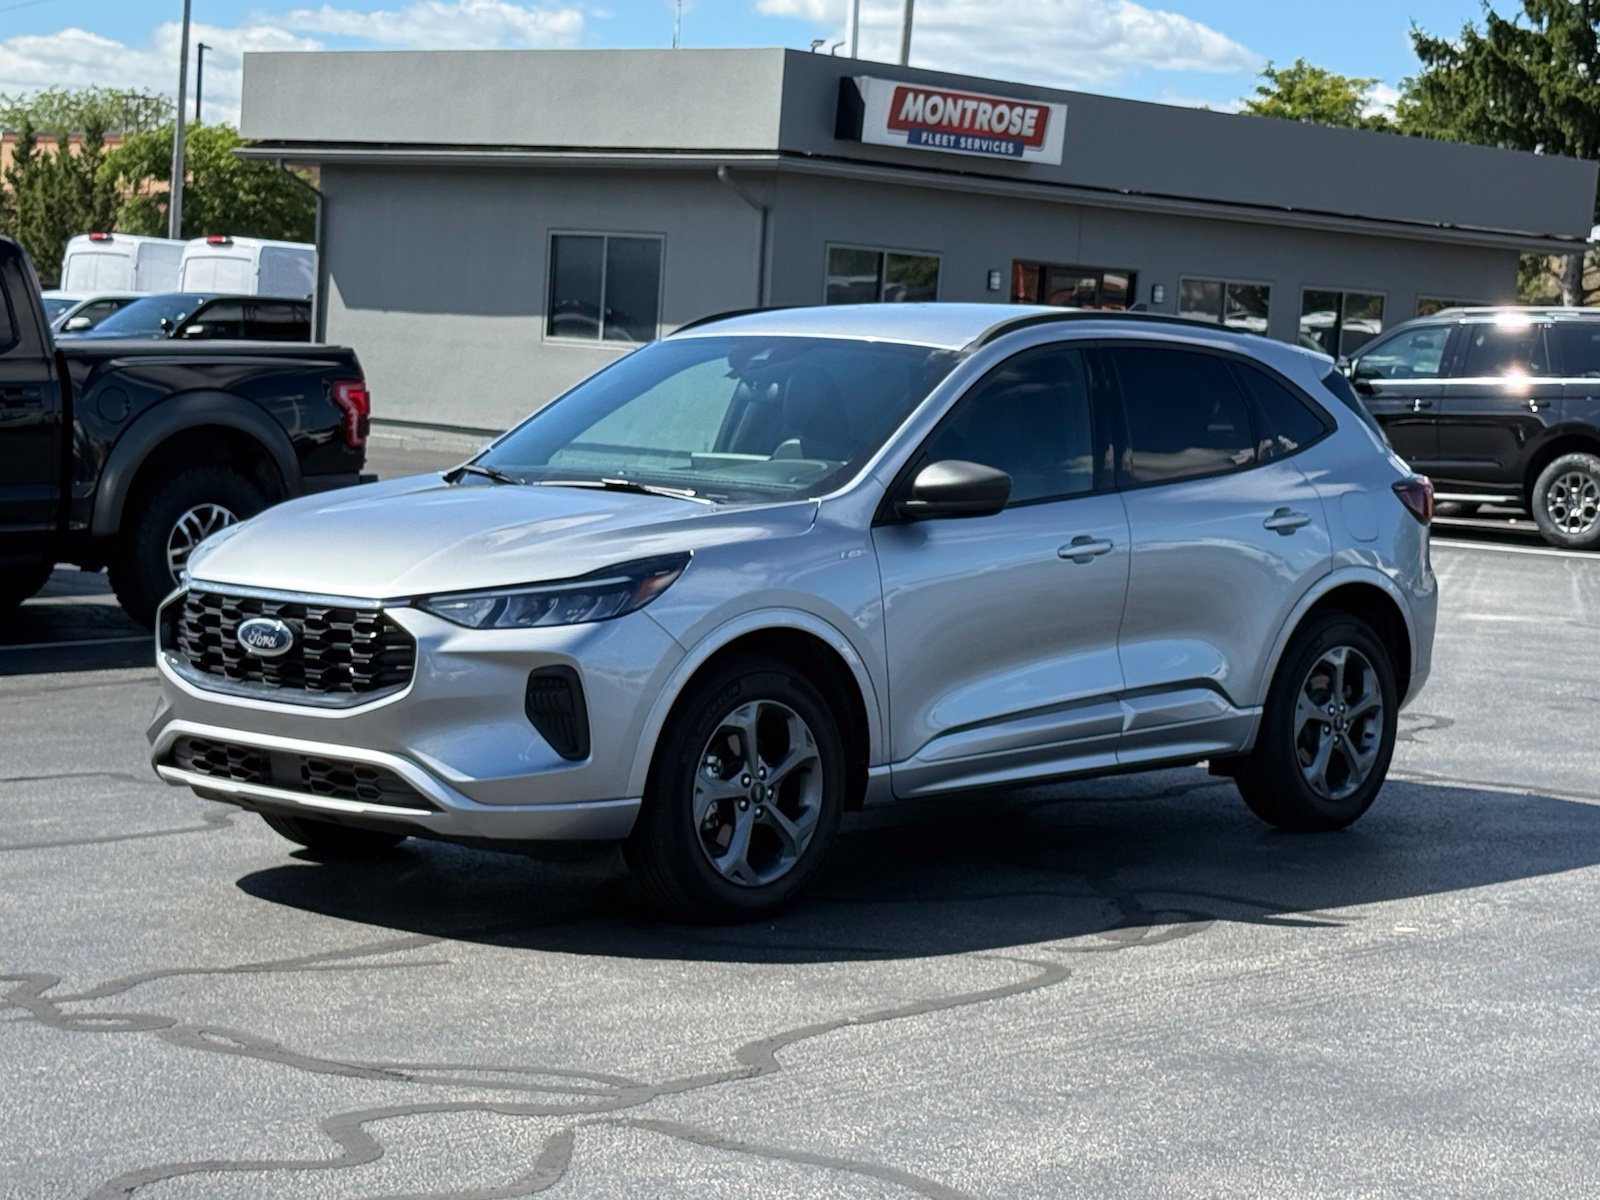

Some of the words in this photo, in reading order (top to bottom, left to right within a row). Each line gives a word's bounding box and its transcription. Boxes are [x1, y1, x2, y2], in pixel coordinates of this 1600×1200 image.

[899, 91, 1039, 137] MONTROSE
[921, 132, 956, 147] FLEET
[959, 135, 1015, 154] SERVICES
[247, 627, 278, 648] Ford
